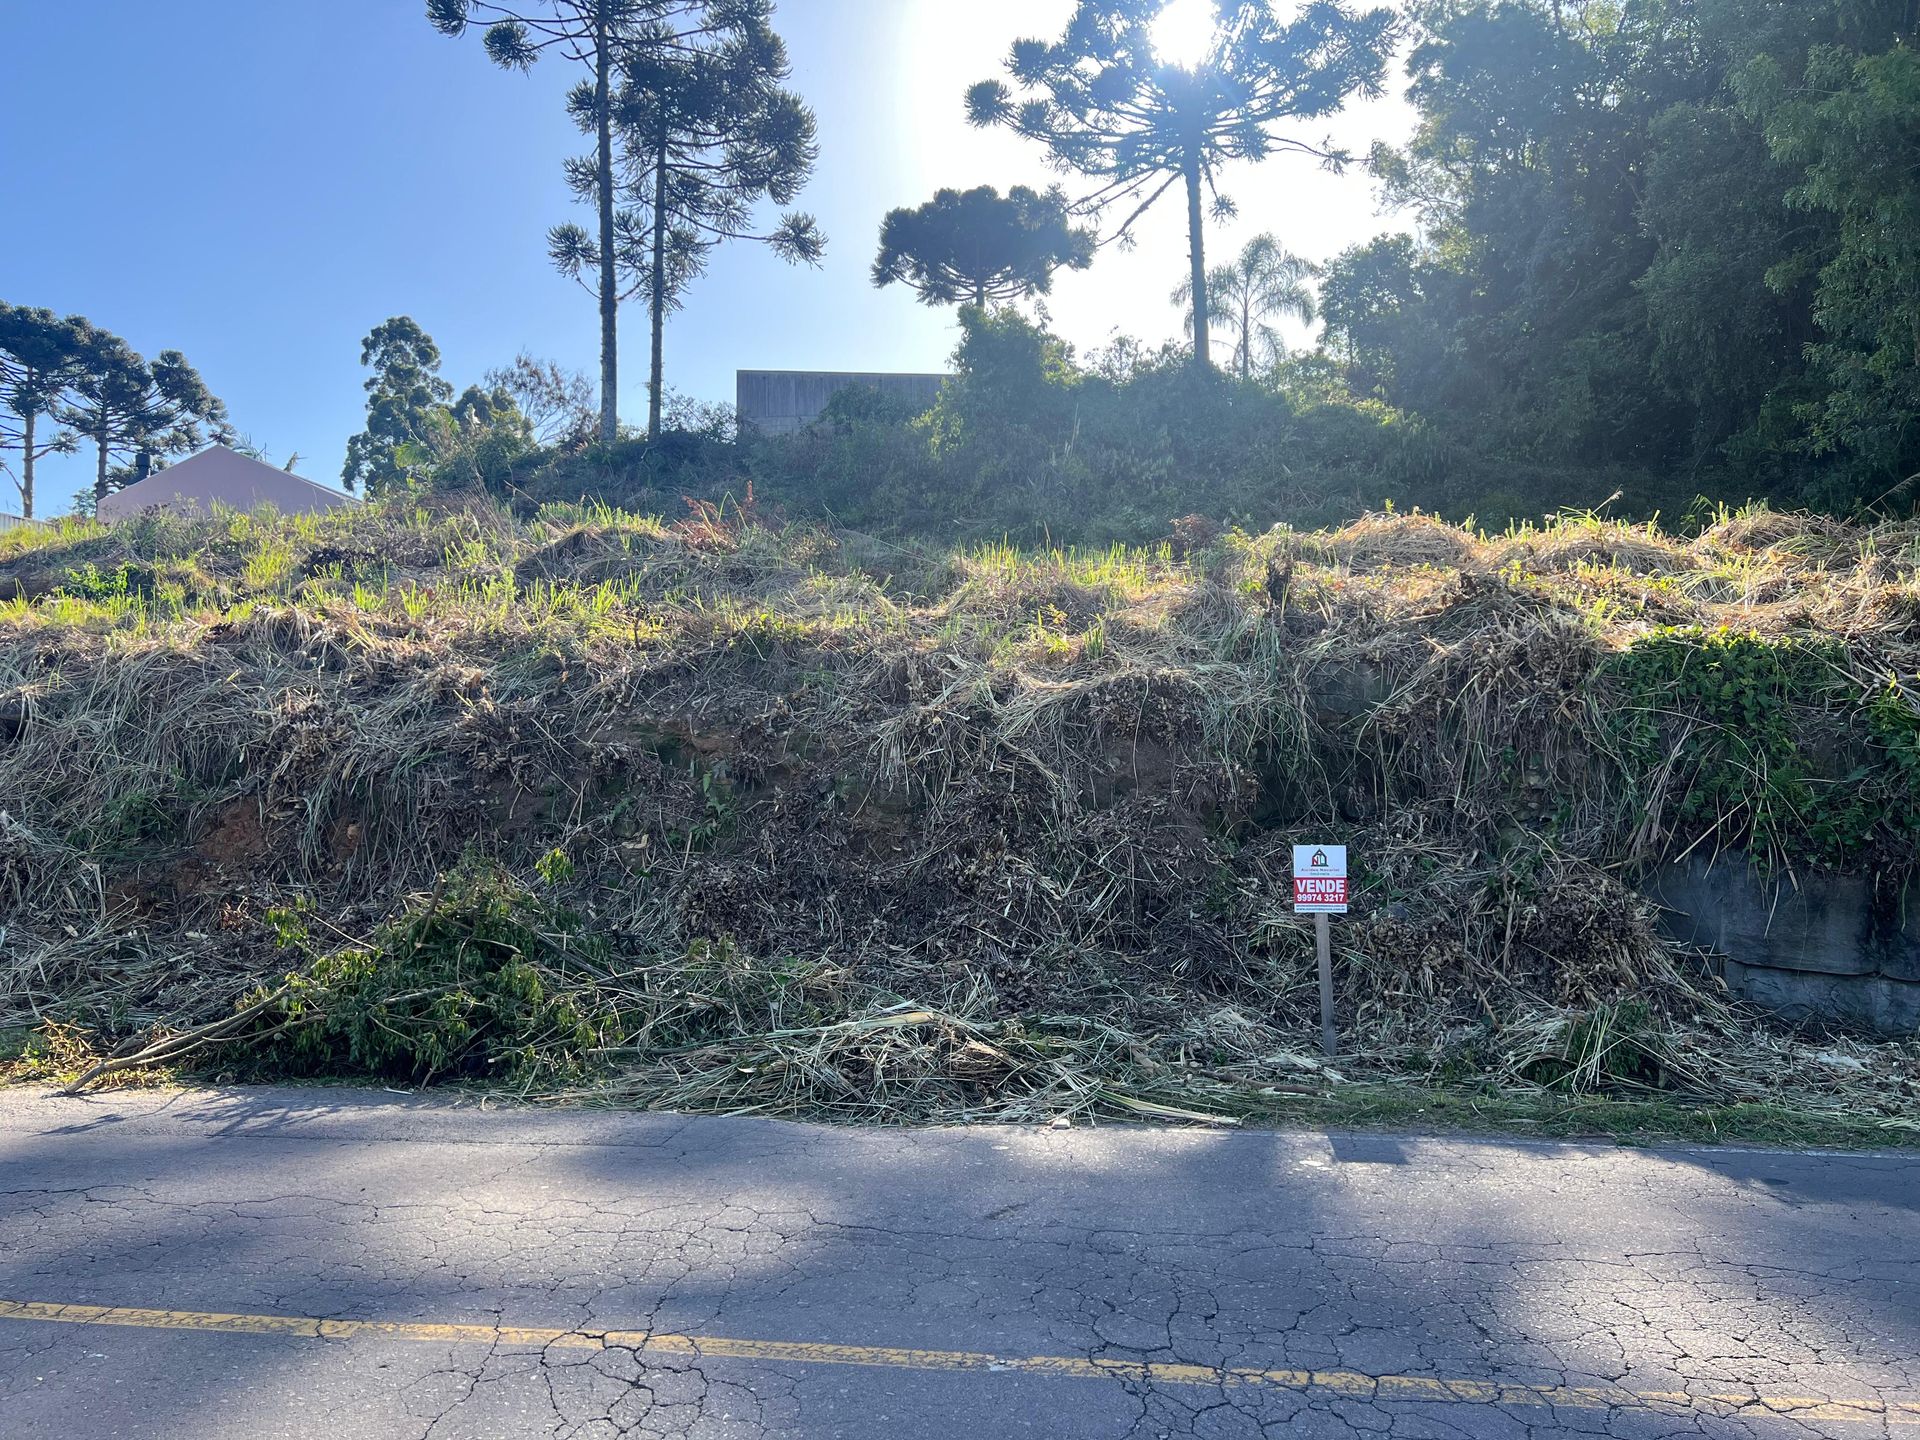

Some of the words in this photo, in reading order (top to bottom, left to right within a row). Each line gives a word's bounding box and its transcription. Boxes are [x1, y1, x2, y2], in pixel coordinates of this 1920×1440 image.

[1296, 879, 1345, 893] VENDE
[1297, 893, 1322, 902] 99974
[1324, 893, 1344, 902] 3217
